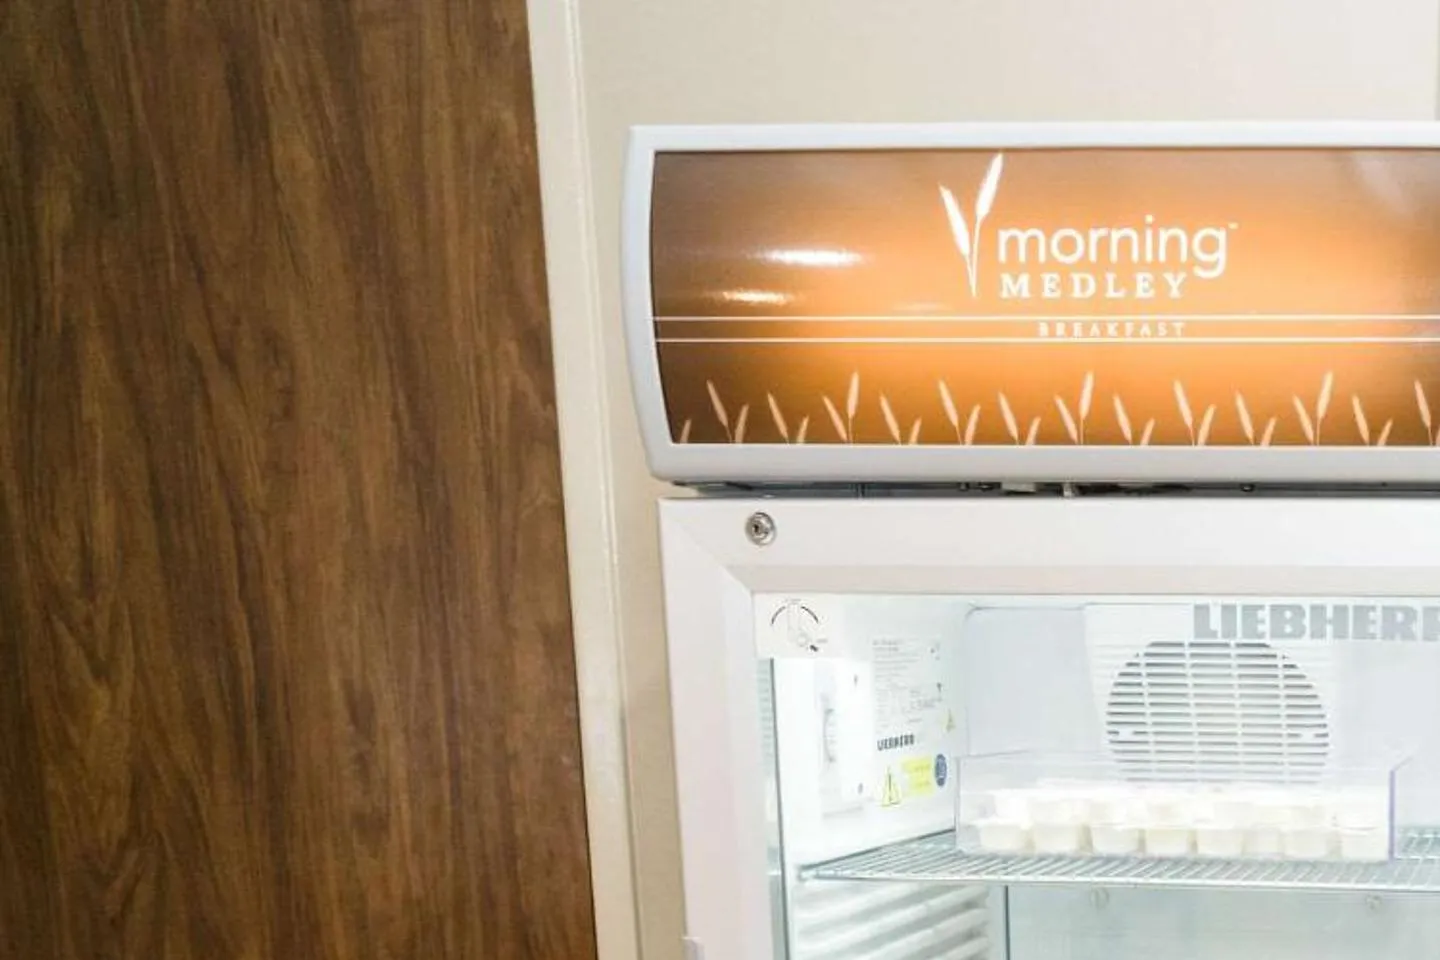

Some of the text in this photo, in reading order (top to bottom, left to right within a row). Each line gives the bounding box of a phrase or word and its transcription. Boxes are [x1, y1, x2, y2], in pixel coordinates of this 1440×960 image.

[998, 214, 1228, 279] morning
[1000, 272, 1188, 299] MEDLEY
[1038, 321, 1187, 338] BREAKFAST
